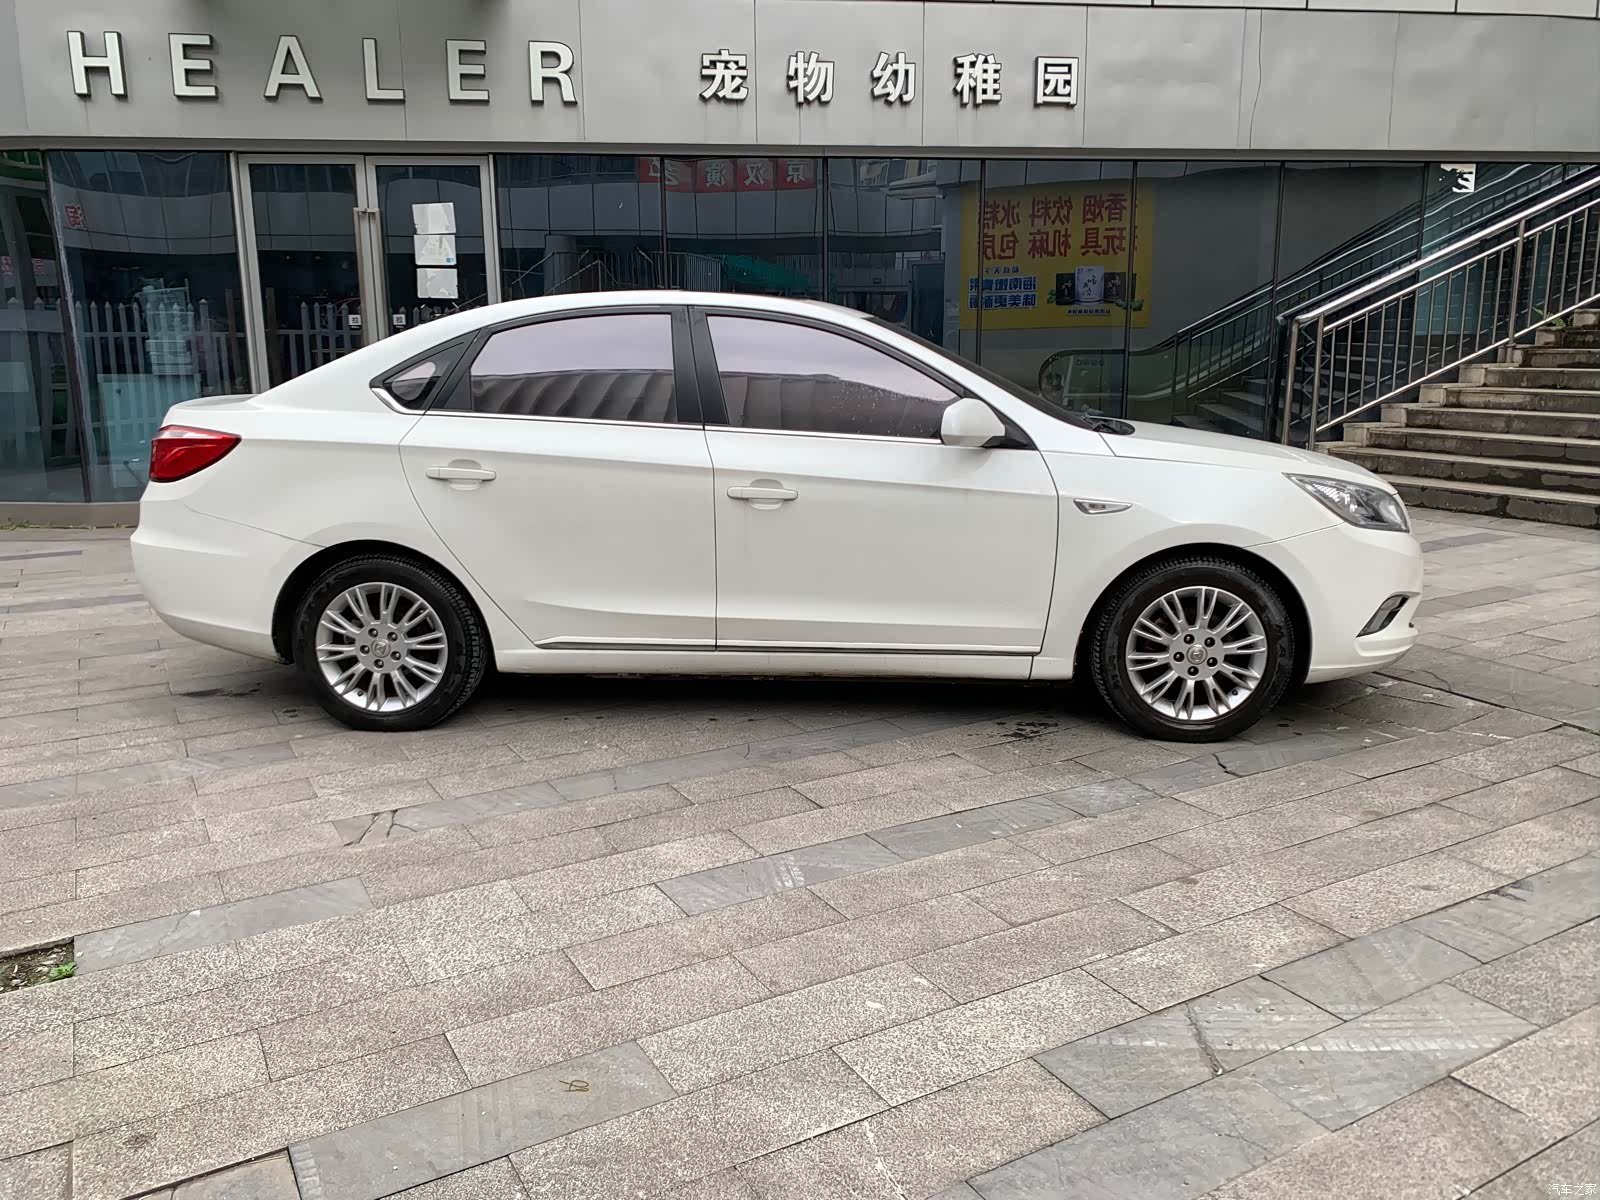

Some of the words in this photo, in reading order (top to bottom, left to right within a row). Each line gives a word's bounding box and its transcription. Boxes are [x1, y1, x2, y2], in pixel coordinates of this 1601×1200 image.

[67, 30, 577, 105] HEALER
[699, 49, 1080, 106] 宠物幼稚园
